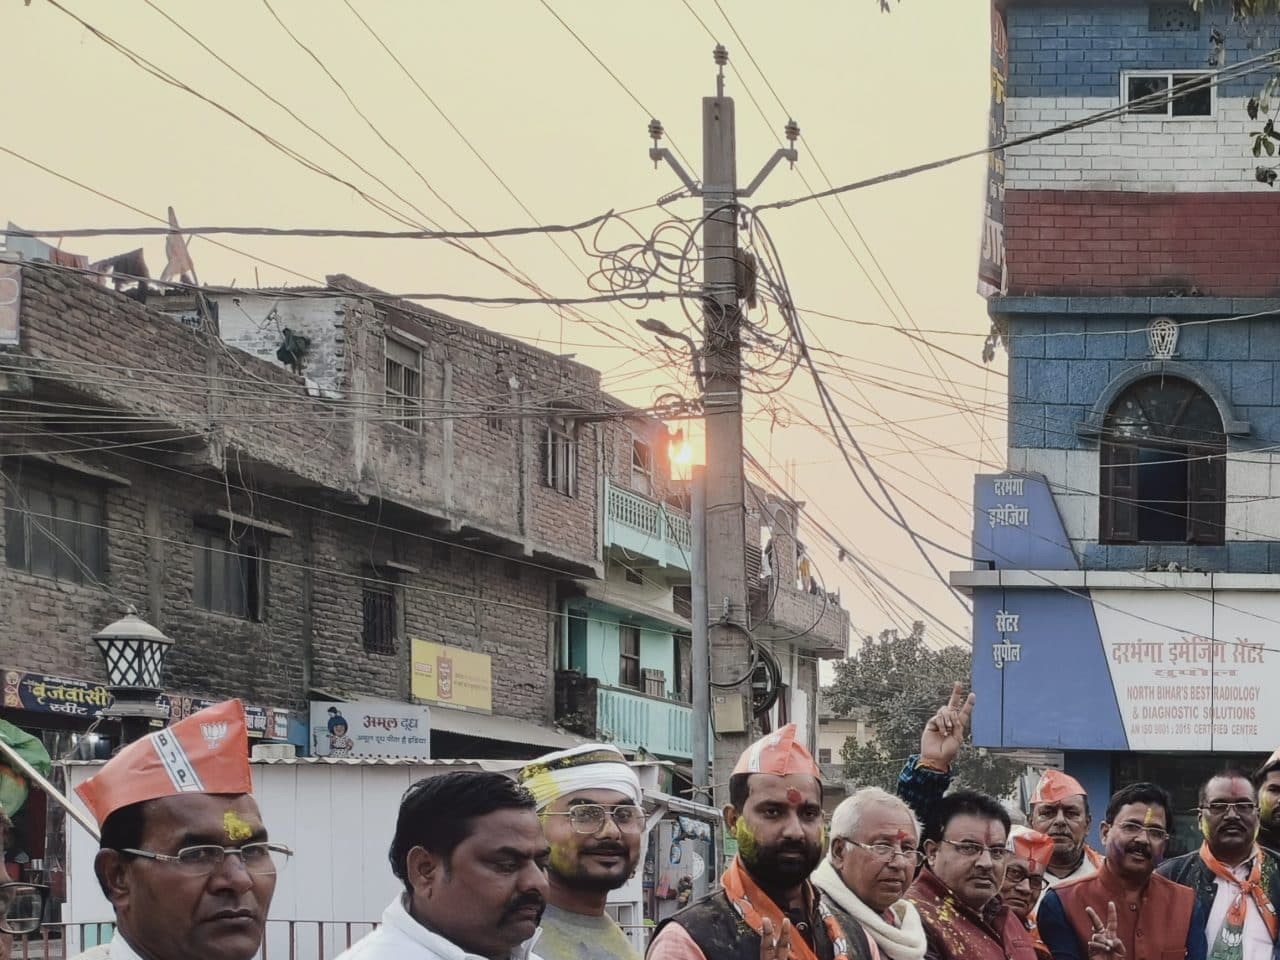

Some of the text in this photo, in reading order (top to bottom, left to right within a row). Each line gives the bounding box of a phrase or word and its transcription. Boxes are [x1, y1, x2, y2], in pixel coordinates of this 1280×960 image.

[1127, 685, 1260, 701] NORTH BIHAR'S BEST RADIOLOGY
[1132, 706, 1256, 720] & DIAGNOSTIC SOLUTIONS
[1141, 723, 1153, 735] ISO
[1193, 724, 1228, 736] CERTIFIED
[1231, 724, 1258, 736] CENTRE
